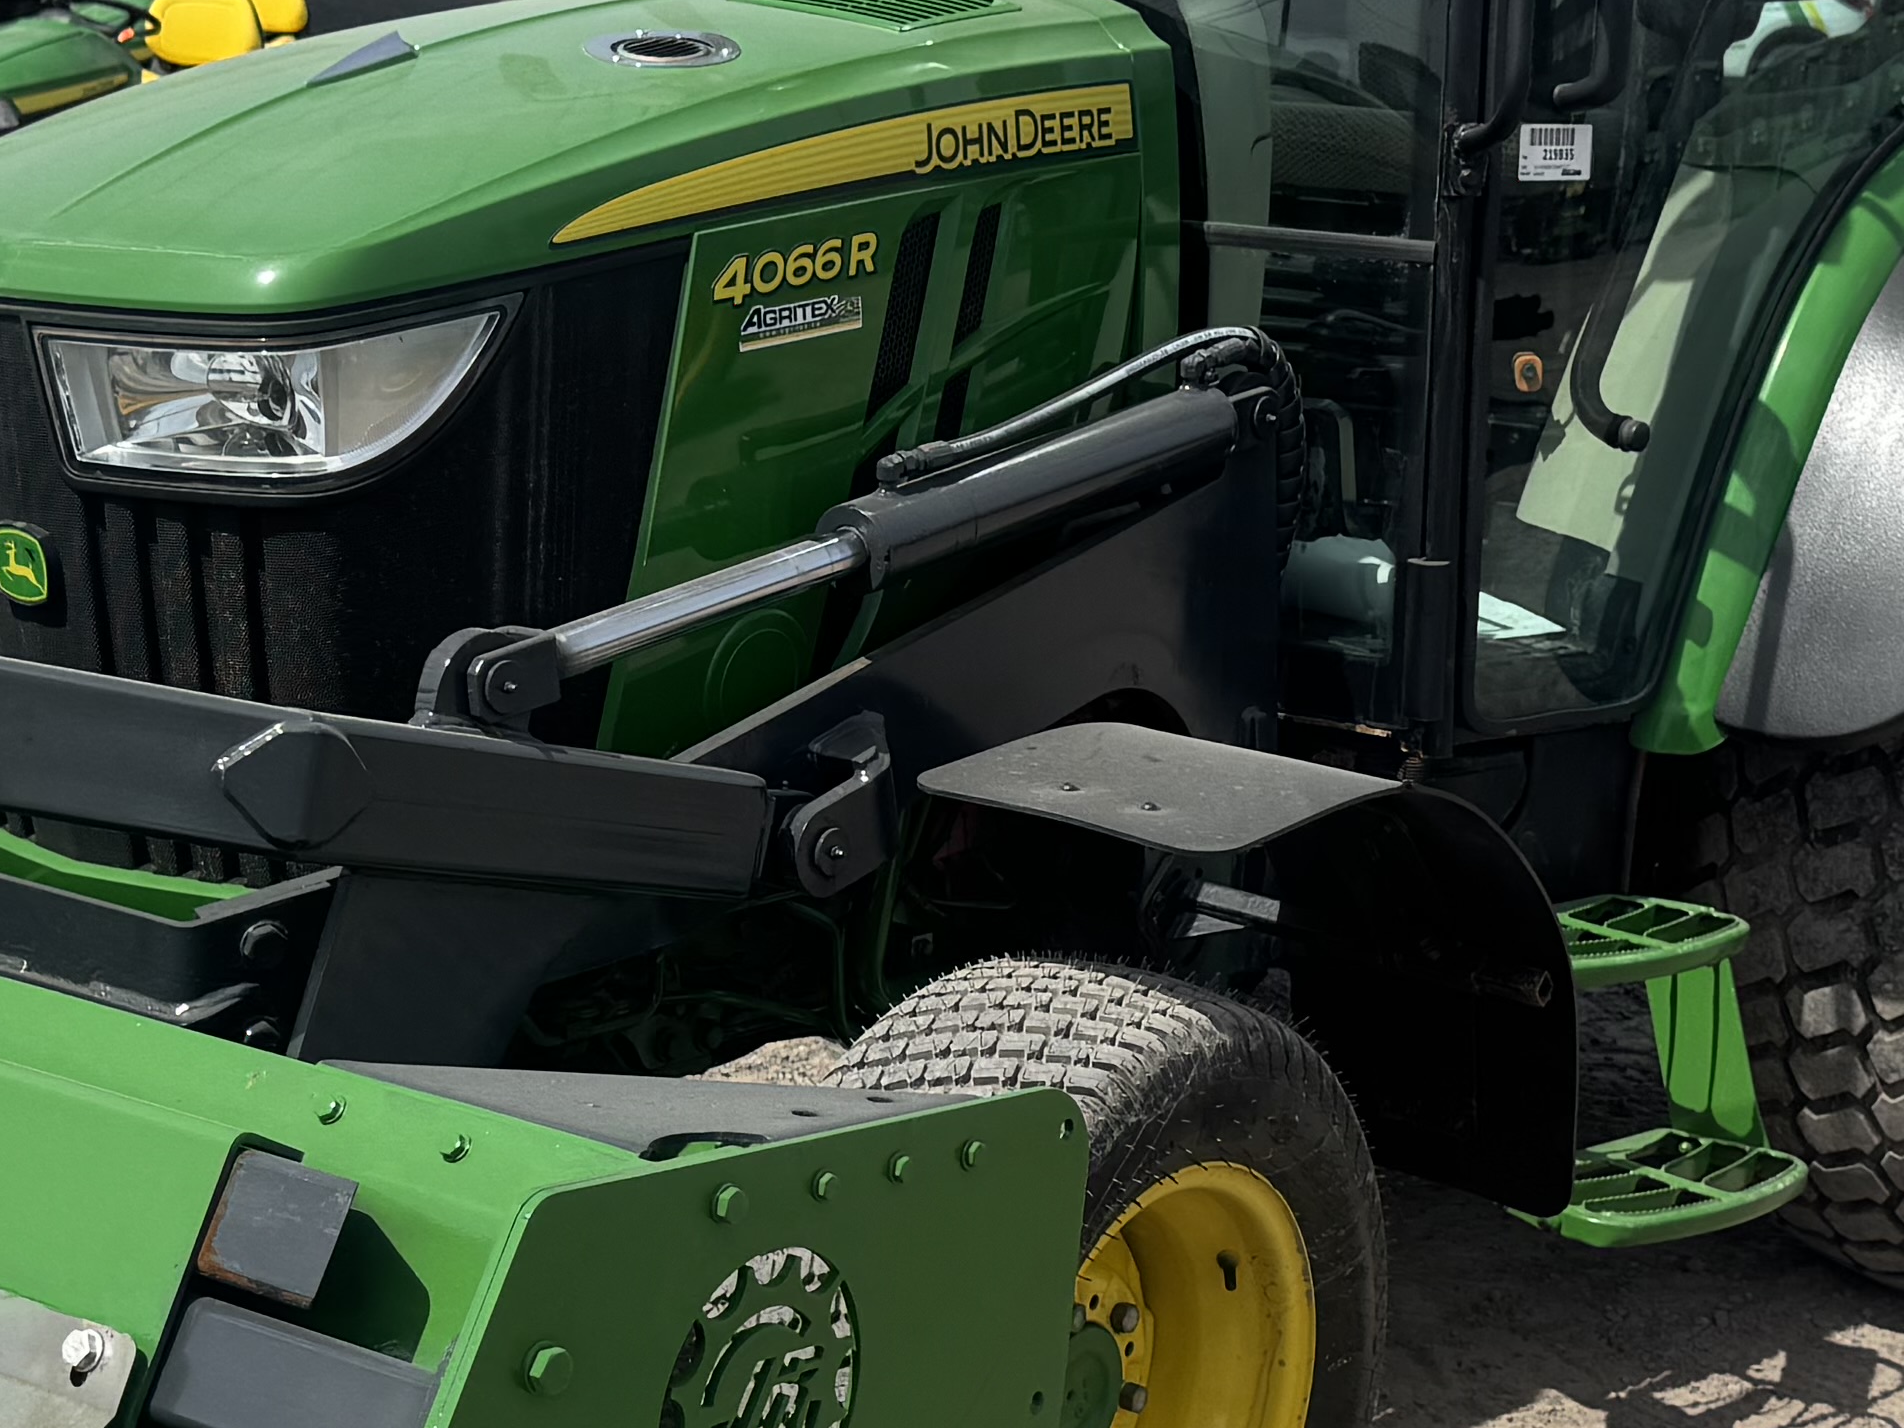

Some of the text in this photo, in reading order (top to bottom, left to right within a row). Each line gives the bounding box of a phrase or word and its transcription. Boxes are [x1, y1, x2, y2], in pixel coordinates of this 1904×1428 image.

[914, 107, 1114, 170] JOHN DEERE
[741, 295, 839, 333] AGRITEX
